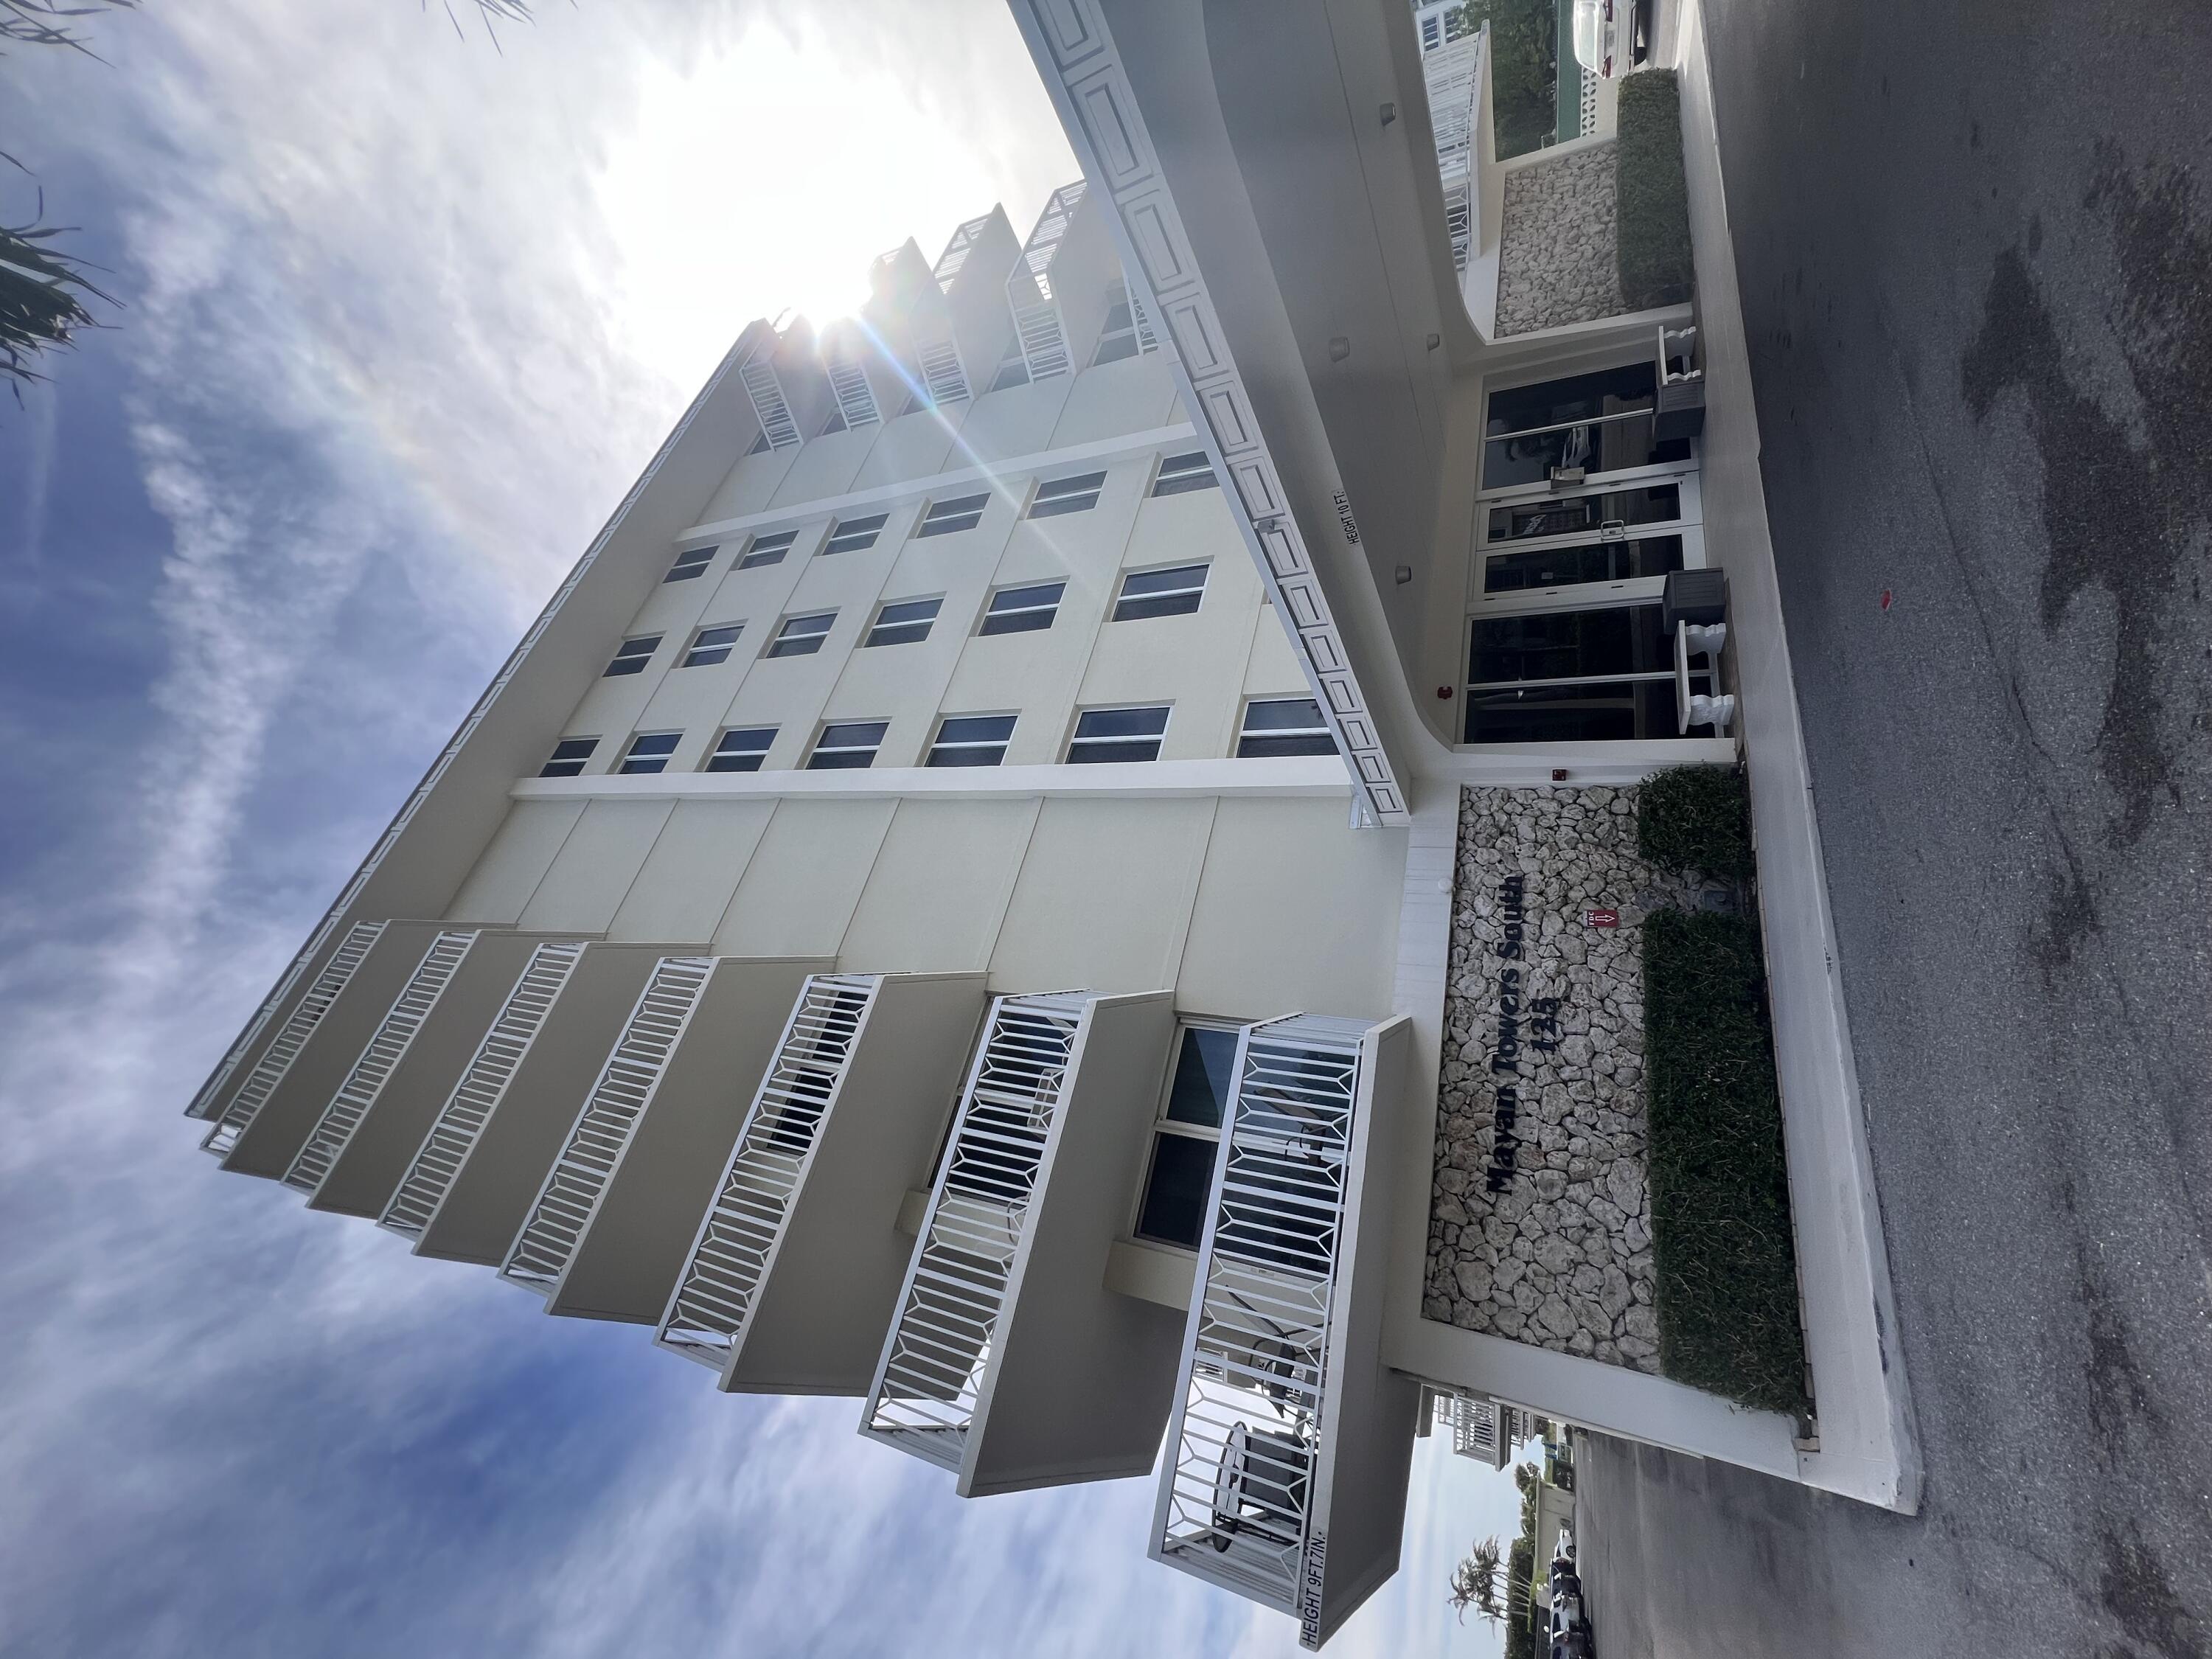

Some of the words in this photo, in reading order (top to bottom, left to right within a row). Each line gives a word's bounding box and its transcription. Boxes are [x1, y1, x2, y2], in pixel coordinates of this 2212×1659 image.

[1338, 505, 1350, 514] 10
[1340, 516, 1360, 544] HEIGHT
[1496, 875, 1523, 959] South
[1491, 968, 1519, 1074] Towers
[1529, 997, 1559, 1052] 125
[1486, 1088, 1521, 1196] Mayan
[1302, 1587, 1321, 1644] HEIGHT
